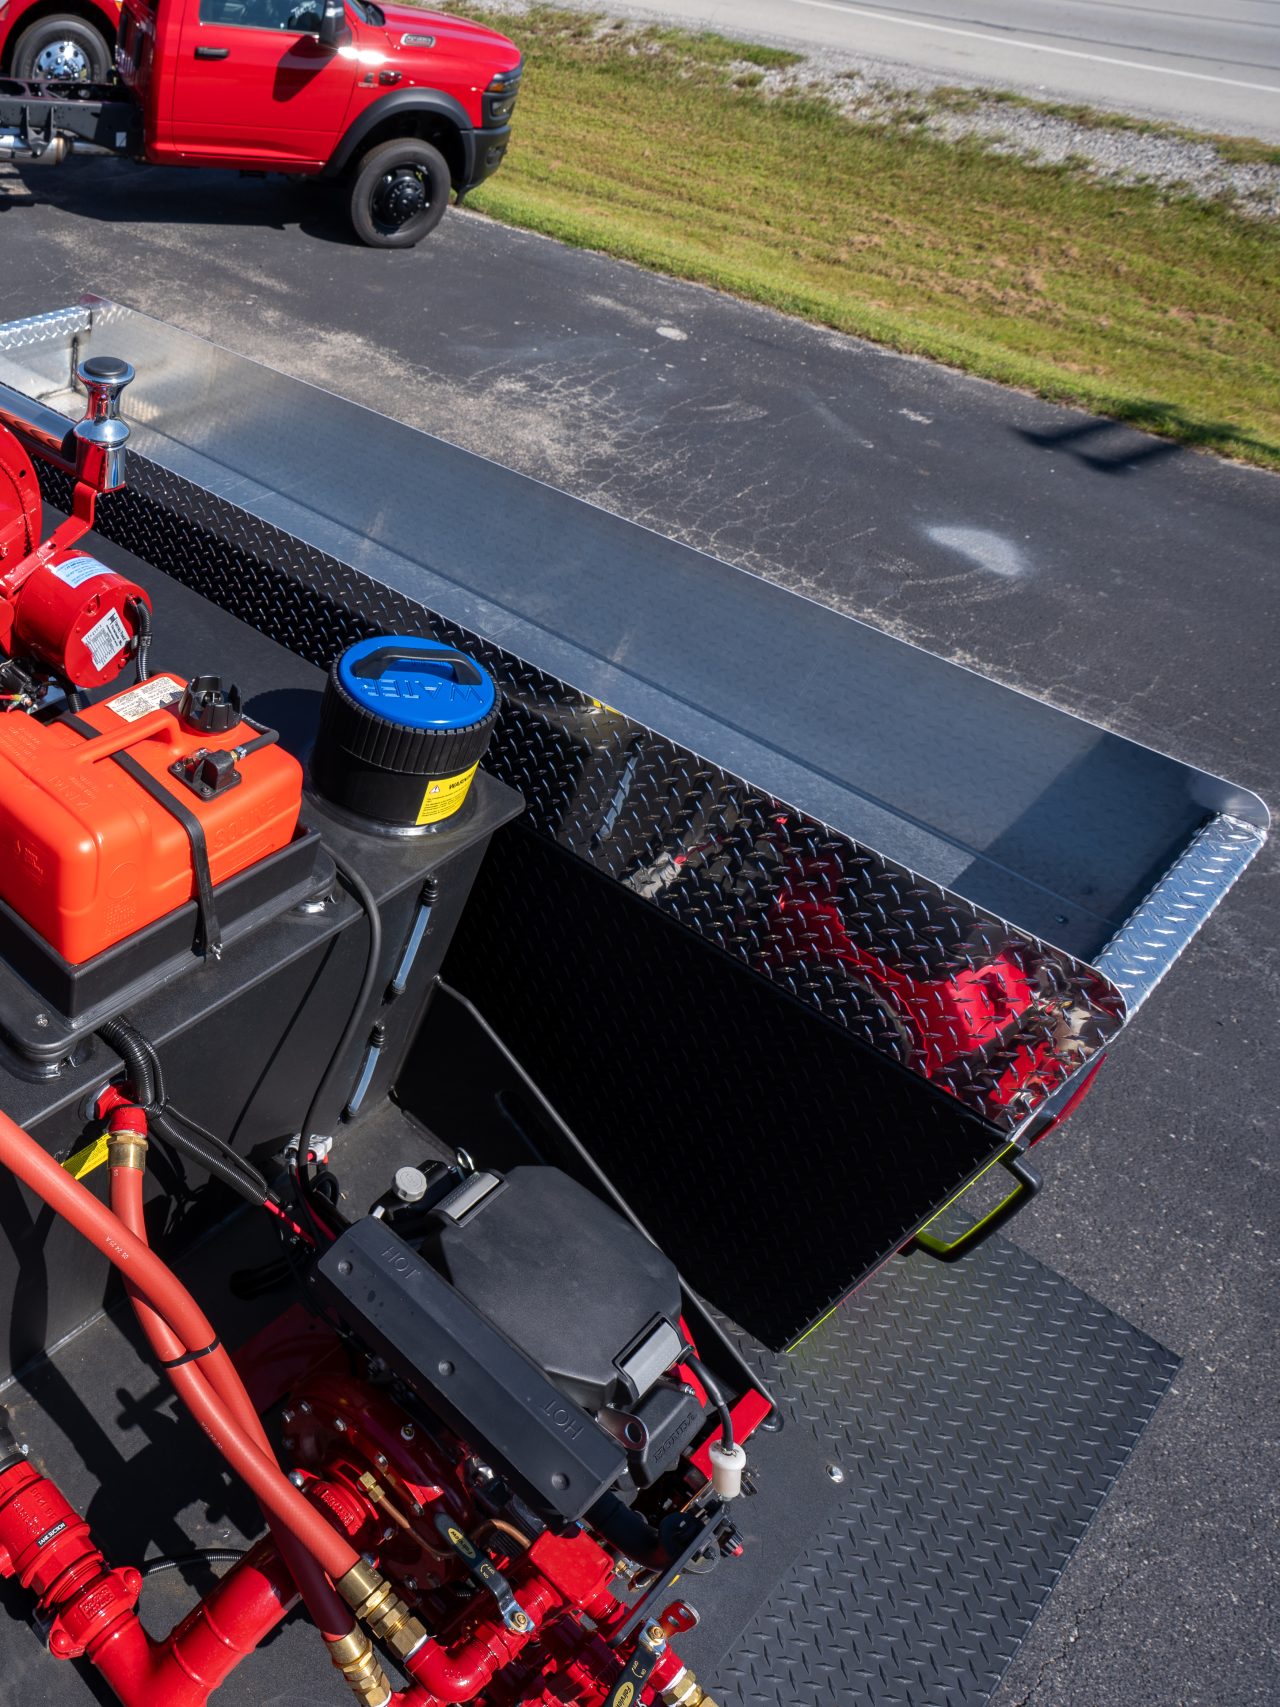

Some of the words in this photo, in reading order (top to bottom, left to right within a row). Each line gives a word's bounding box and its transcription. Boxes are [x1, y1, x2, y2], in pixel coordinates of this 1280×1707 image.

[357, 677, 484, 704] WATER
[380, 1246, 422, 1279] HOT
[543, 1400, 585, 1440] HOT
[37, 1534, 50, 1546] TANK
[48, 1522, 66, 1537] SUCTION
[450, 1531, 473, 1555] Fairview
[615, 1685, 632, 1707] Fairvie
